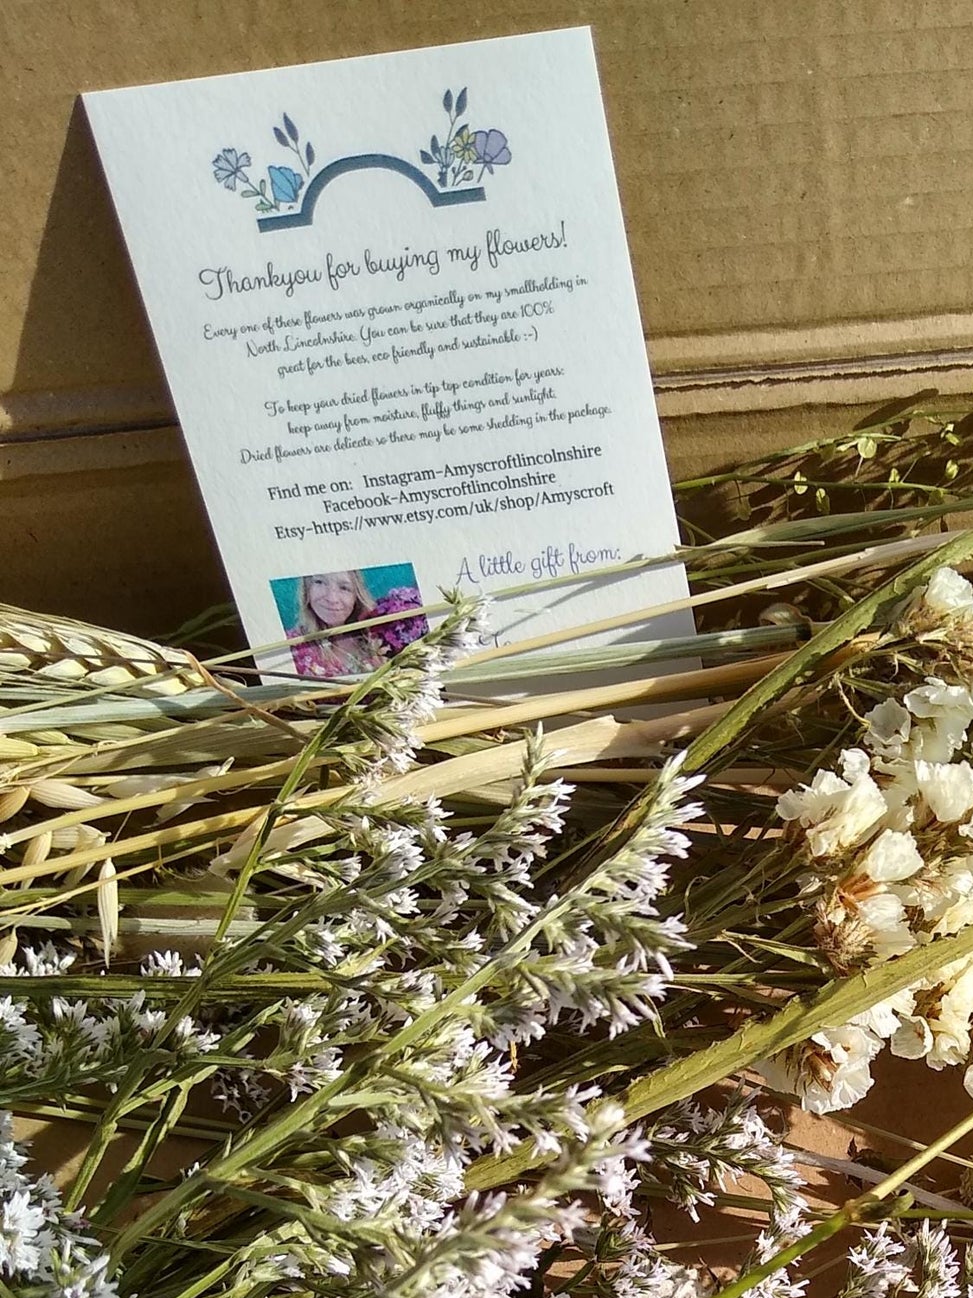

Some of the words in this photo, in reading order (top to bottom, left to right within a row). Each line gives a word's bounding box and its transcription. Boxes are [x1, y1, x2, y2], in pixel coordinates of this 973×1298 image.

[199, 262, 322, 300] Thankyou
[327, 253, 360, 290] for
[364, 247, 440, 281] buying
[447, 246, 481, 271] my
[487, 221, 567, 268] flowers!
[203, 323, 237, 340] Every
[240, 323, 260, 334] one
[262, 317, 276, 336] of
[276, 315, 301, 328] these
[304, 310, 342, 330] flowers
[345, 308, 365, 319] was
[368, 305, 400, 320] grown
[404, 291, 465, 314] organically
[468, 290, 482, 302] on
[485, 289, 501, 303] my
[504, 276, 572, 296] smallholding
[576, 274, 588, 286] in
[247, 340, 280, 357] North
[360, 324, 385, 346] You
[388, 326, 408, 336] can
[410, 320, 424, 332] be
[426, 320, 448, 331] sure
[449, 312, 474, 327] that
[474, 310, 498, 326] they
[501, 311, 518, 320] are
[520, 300, 555, 318] 100%
[278, 360, 304, 378] great
[307, 358, 324, 376] for
[326, 354, 342, 368] the
[372, 352, 389, 362] eco
[392, 343, 435, 364] friendly
[438, 338, 460, 351] and
[462, 328, 521, 348] sustainable
[264, 401, 284, 416] To
[287, 400, 312, 415] keep
[313, 399, 338, 414] your
[341, 390, 368, 406] dried
[371, 387, 408, 406] flowers
[411, 384, 422, 394] in
[424, 382, 440, 398] tip
[442, 380, 460, 396] top
[462, 372, 514, 388] condition
[514, 368, 532, 386] for
[288, 422, 312, 437] keep
[314, 420, 342, 433] away
[344, 414, 370, 432] from
[422, 400, 451, 421] fluffy
[453, 398, 486, 413] things
[488, 394, 509, 406] and
[240, 448, 274, 464] Dried
[276, 446, 312, 463] flowers
[314, 444, 331, 454] are
[334, 436, 374, 452] delicate
[376, 436, 388, 445] so
[389, 431, 416, 444] there
[419, 429, 440, 442] may
[443, 424, 456, 436] be
[458, 424, 484, 434] some
[486, 416, 533, 430] shedding
[536, 412, 548, 422] in
[550, 410, 566, 421] the
[267, 484, 301, 500] Find
[304, 484, 326, 496] me
[330, 480, 353, 492] on:
[456, 558, 478, 584] A
[479, 552, 524, 577] little
[531, 546, 564, 578] gift
[569, 542, 622, 573] from:
